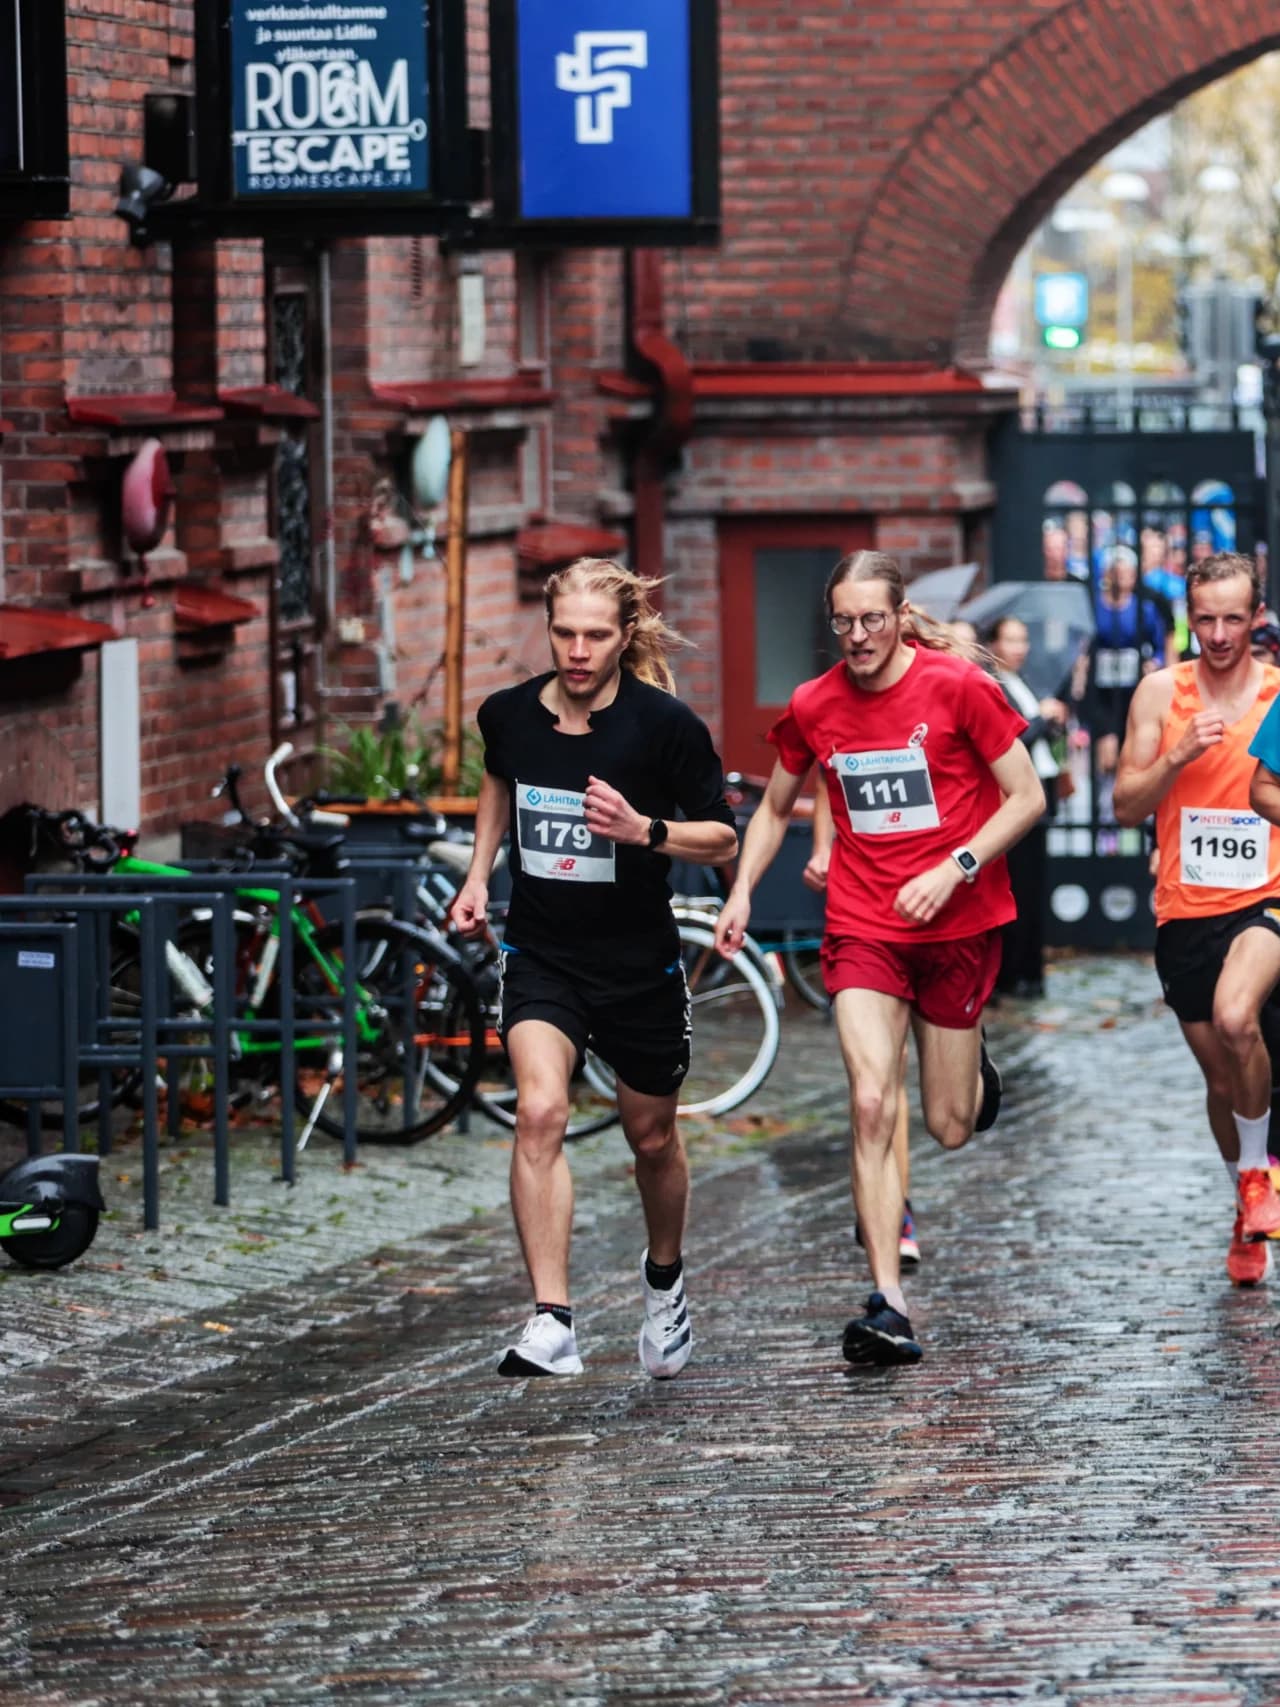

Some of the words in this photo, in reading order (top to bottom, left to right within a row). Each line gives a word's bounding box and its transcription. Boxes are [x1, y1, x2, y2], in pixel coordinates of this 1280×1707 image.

[255, 26, 272, 45] ja
[273, 26, 333, 42] suuntaa
[334, 24, 378, 41] Lidlin
[248, 134, 411, 174] ESCAPE
[249, 171, 412, 190] ROOMESCAPE.FI
[859, 778, 908, 806] 111
[534, 820, 592, 850] 179
[1191, 835, 1257, 860] 1196
